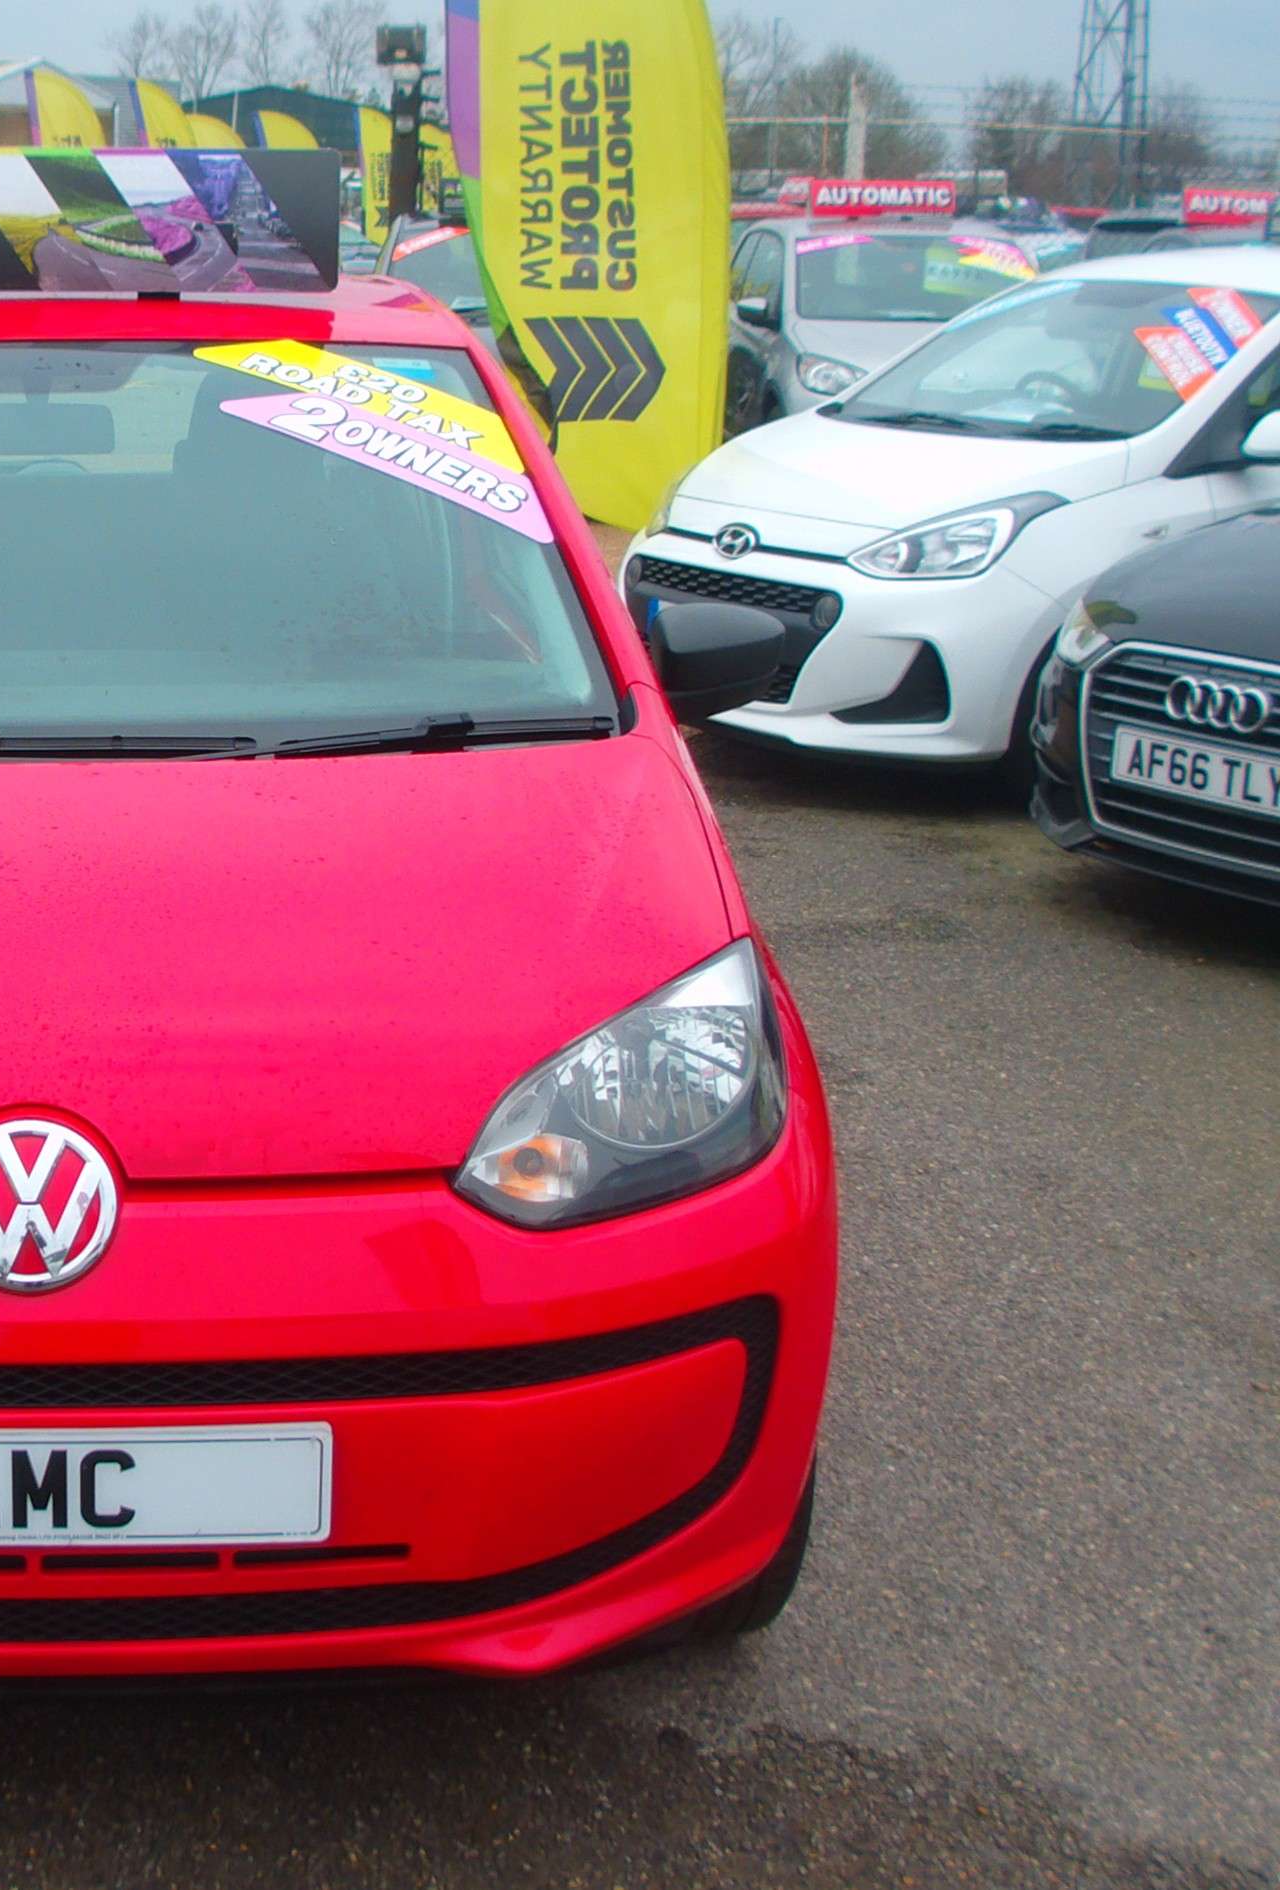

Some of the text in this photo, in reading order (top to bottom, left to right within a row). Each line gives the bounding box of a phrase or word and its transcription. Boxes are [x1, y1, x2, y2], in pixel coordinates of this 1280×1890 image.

[816, 186, 951, 206] AUTOMATIC
[240, 353, 485, 450] ROAD TAX
[334, 364, 428, 403] £20
[270, 397, 529, 513] 2 OWNERS
[1128, 740, 1280, 806] AF66 TLY
